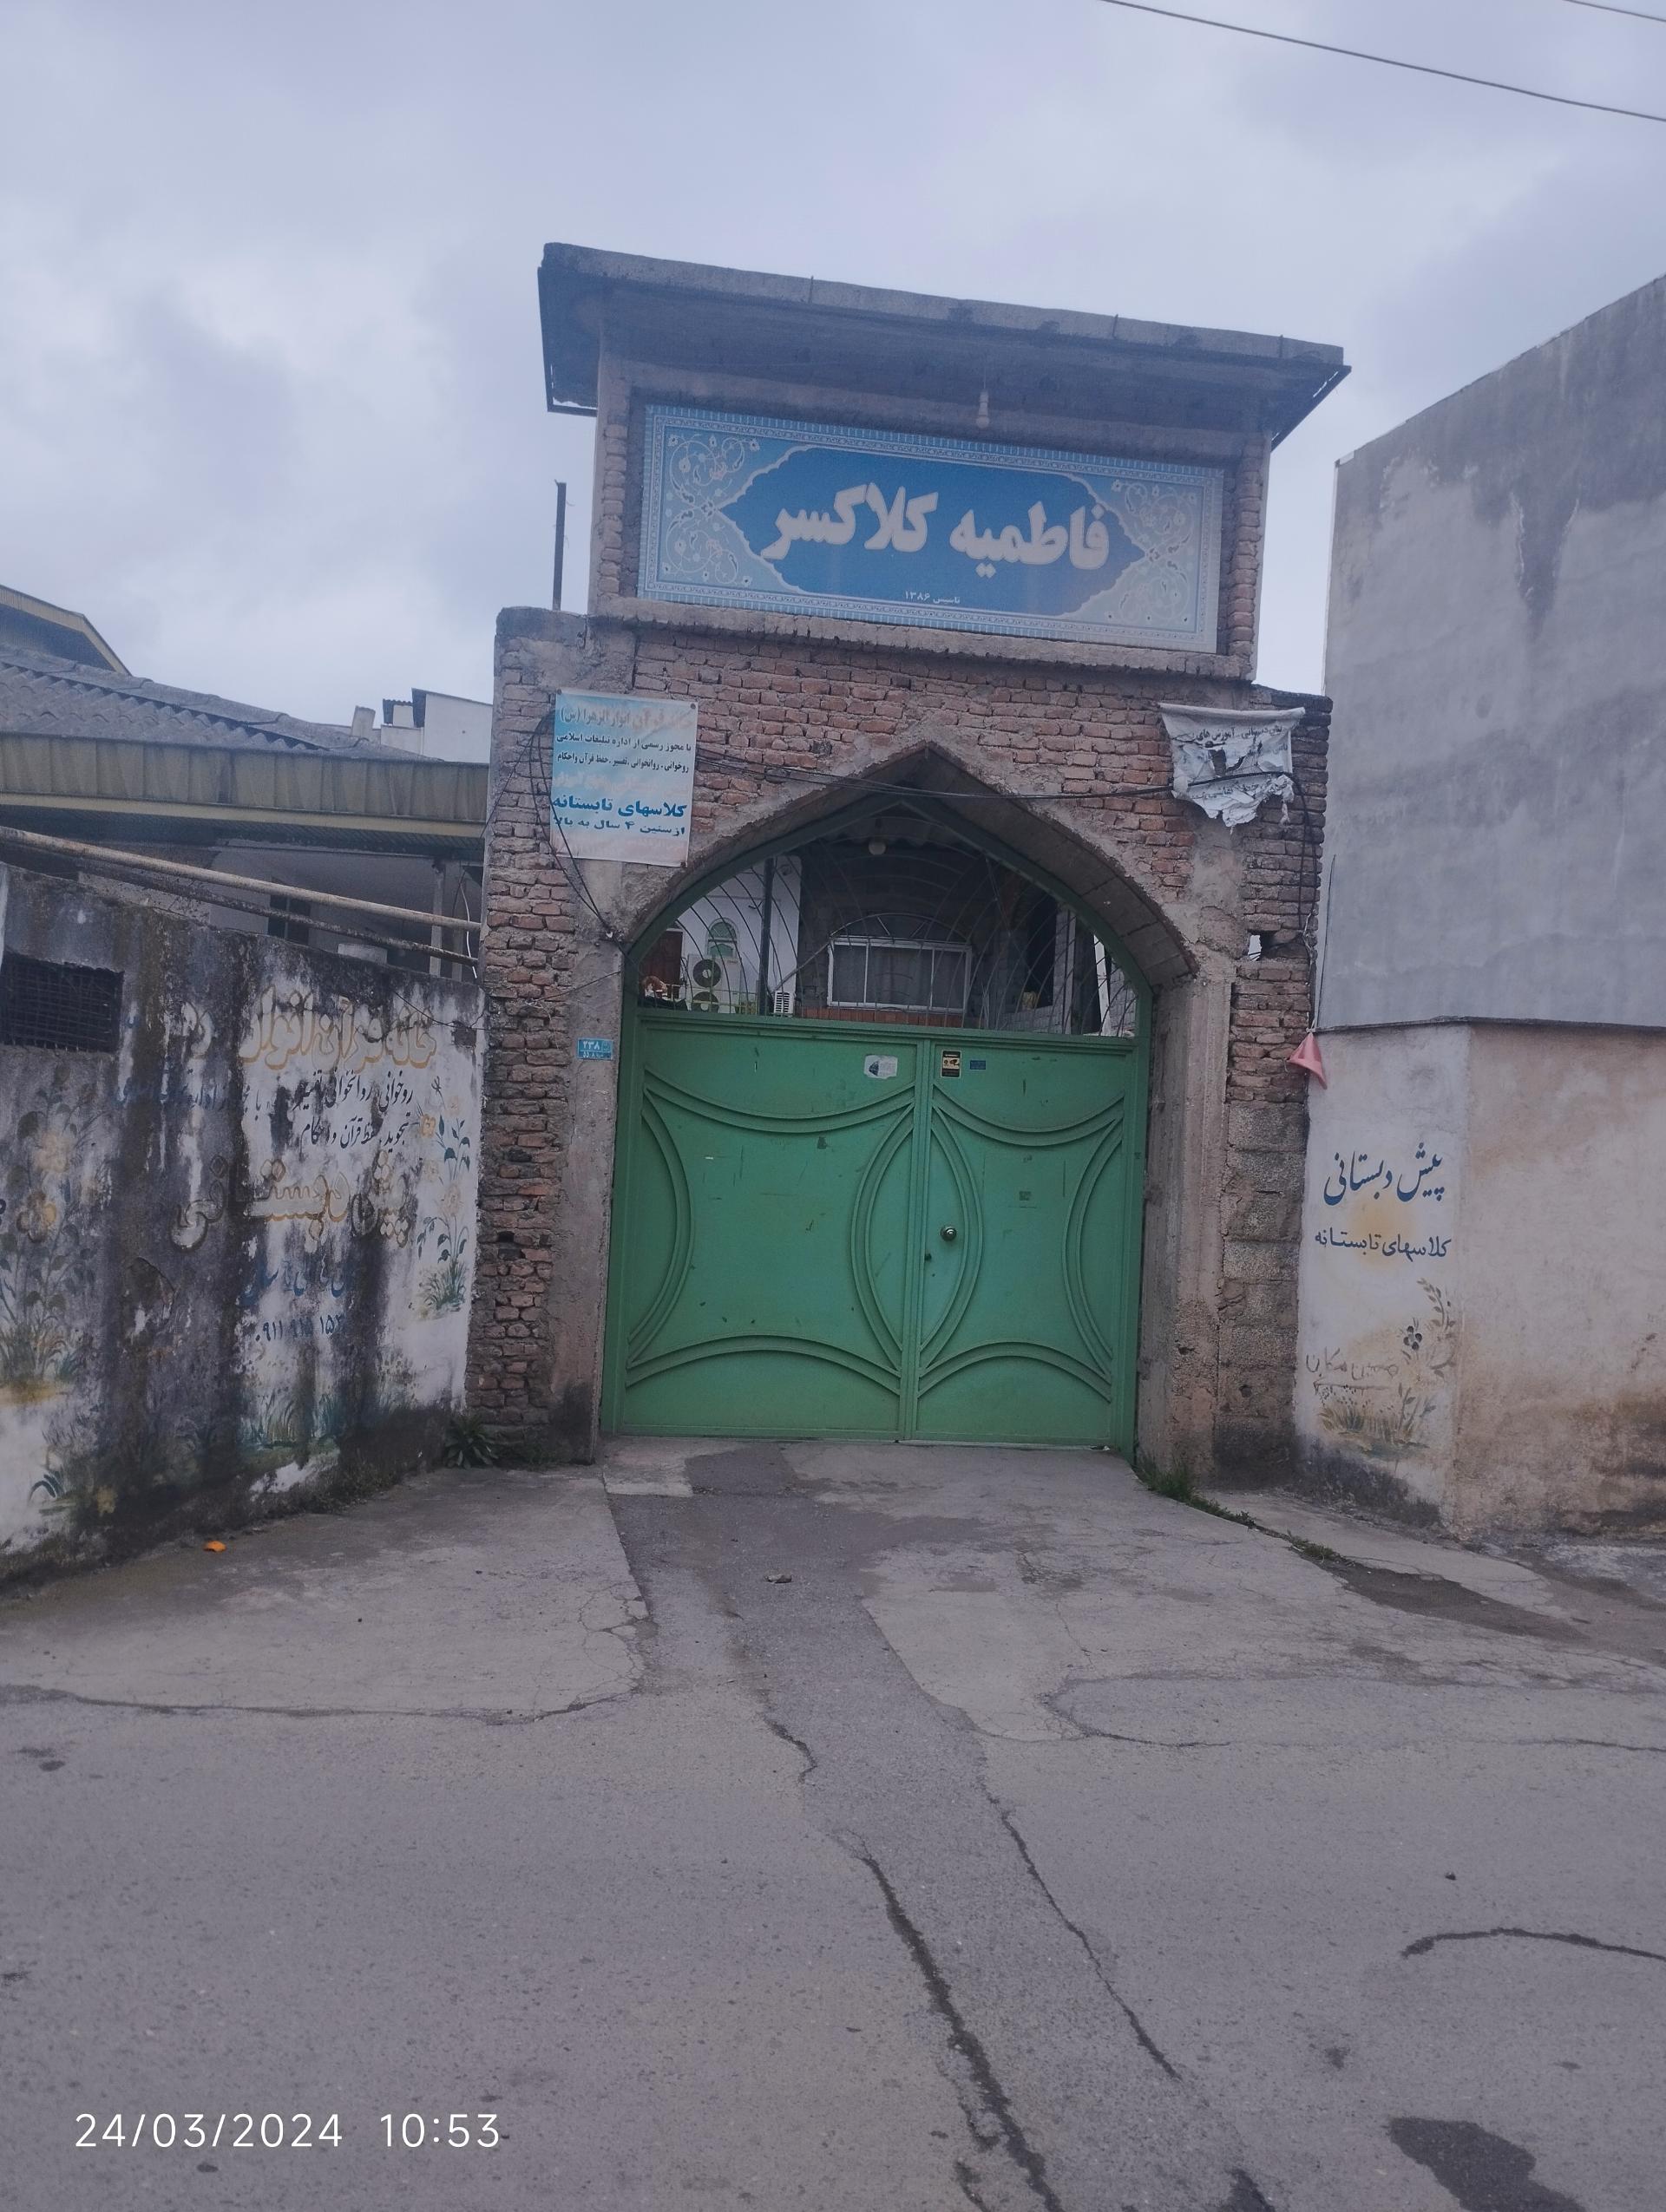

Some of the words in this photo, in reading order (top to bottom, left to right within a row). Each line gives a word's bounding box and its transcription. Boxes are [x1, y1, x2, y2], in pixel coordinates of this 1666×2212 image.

[761, 482, 938, 561] کلاکسر
[949, 501, 1111, 578] فاطمیه
[556, 733, 583, 743] اسلامی
[585, 735, 610, 747] تبلیغات
[612, 738, 631, 748] اداره
[633, 740, 640, 749] از
[641, 742, 663, 752] رسمی
[552, 795, 613, 815] تابستانه
[618, 800, 687, 818] کلاسهای
[578, 820, 590, 828] به
[594, 819, 620, 829] سال
[625, 821, 634, 829] ۴
[378, 1070, 414, 1112] روخوانی
[340, 1115, 363, 1149] قرآن
[1323, 1150, 1393, 1206] دبستانی
[1396, 1142, 1445, 1201] پیش
[1315, 1227, 1381, 1256] تابستانه
[1381, 1234, 1451, 1261] کلاسهای
